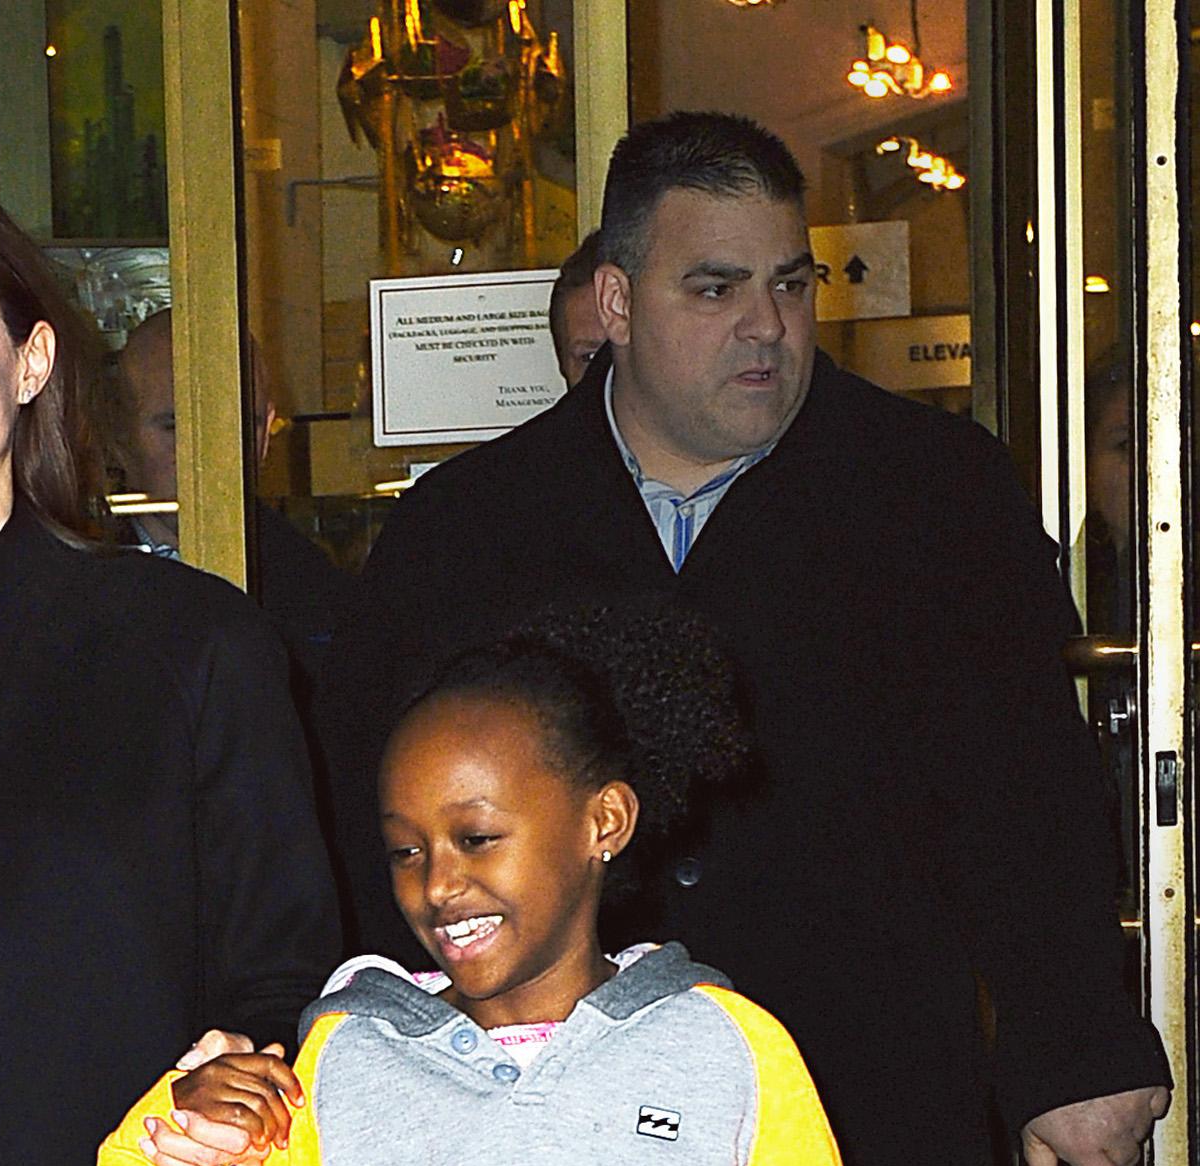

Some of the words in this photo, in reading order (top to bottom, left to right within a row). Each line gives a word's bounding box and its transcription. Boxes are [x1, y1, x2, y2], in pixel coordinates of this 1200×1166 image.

[396, 316, 414, 326] ALL
[415, 314, 454, 325] MEDIUM
[455, 313, 476, 322] AND
[477, 311, 506, 321] LARGE
[508, 310, 528, 320] SIZE
[480, 325, 497, 334] AND
[497, 323, 534, 333] SHOPPING
[415, 341, 440, 352] MUST
[441, 341, 453, 351] BE
[455, 338, 498, 350] CHECKED
[499, 338, 510, 348] IN
[510, 336, 536, 346] WITH
[452, 353, 497, 363] SECURITY
